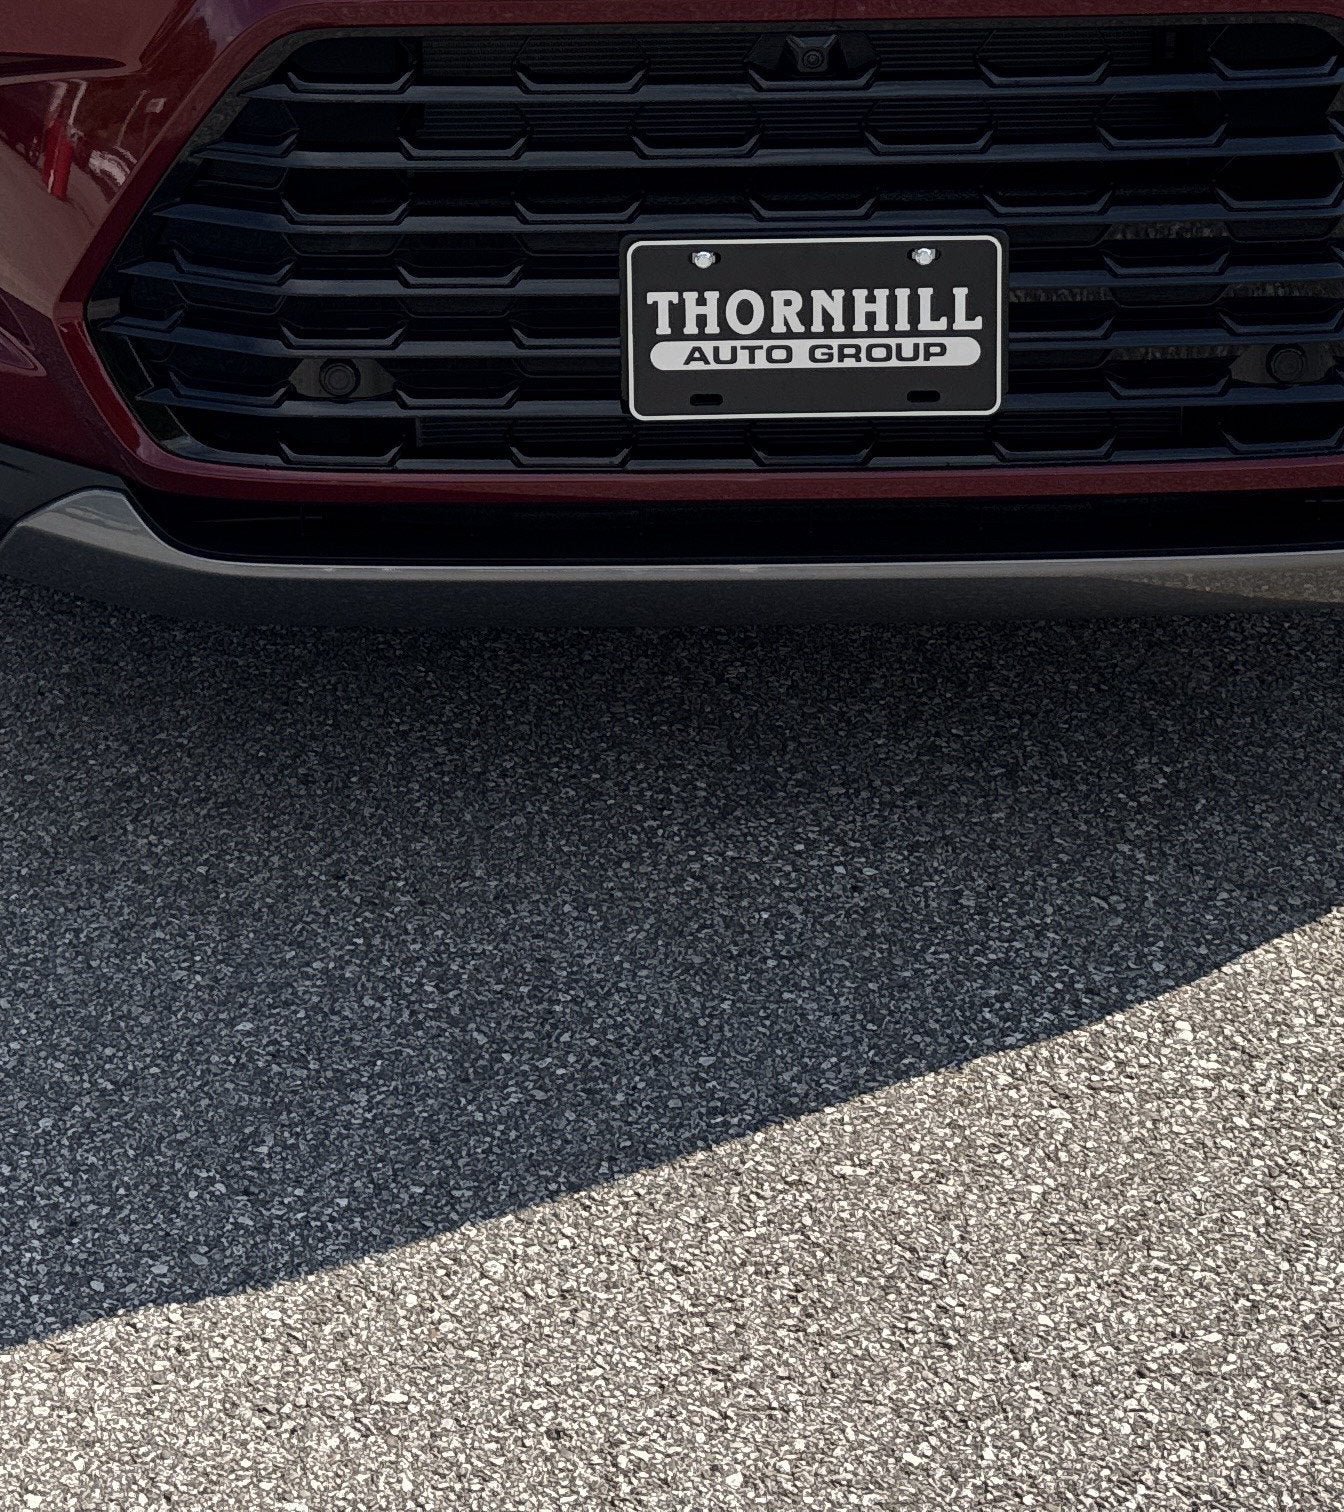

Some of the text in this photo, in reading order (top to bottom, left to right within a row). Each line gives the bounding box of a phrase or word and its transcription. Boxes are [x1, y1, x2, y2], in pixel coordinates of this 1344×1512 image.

[646, 287, 983, 335] THORNHILL
[683, 341, 948, 366] AUTO GROUP
